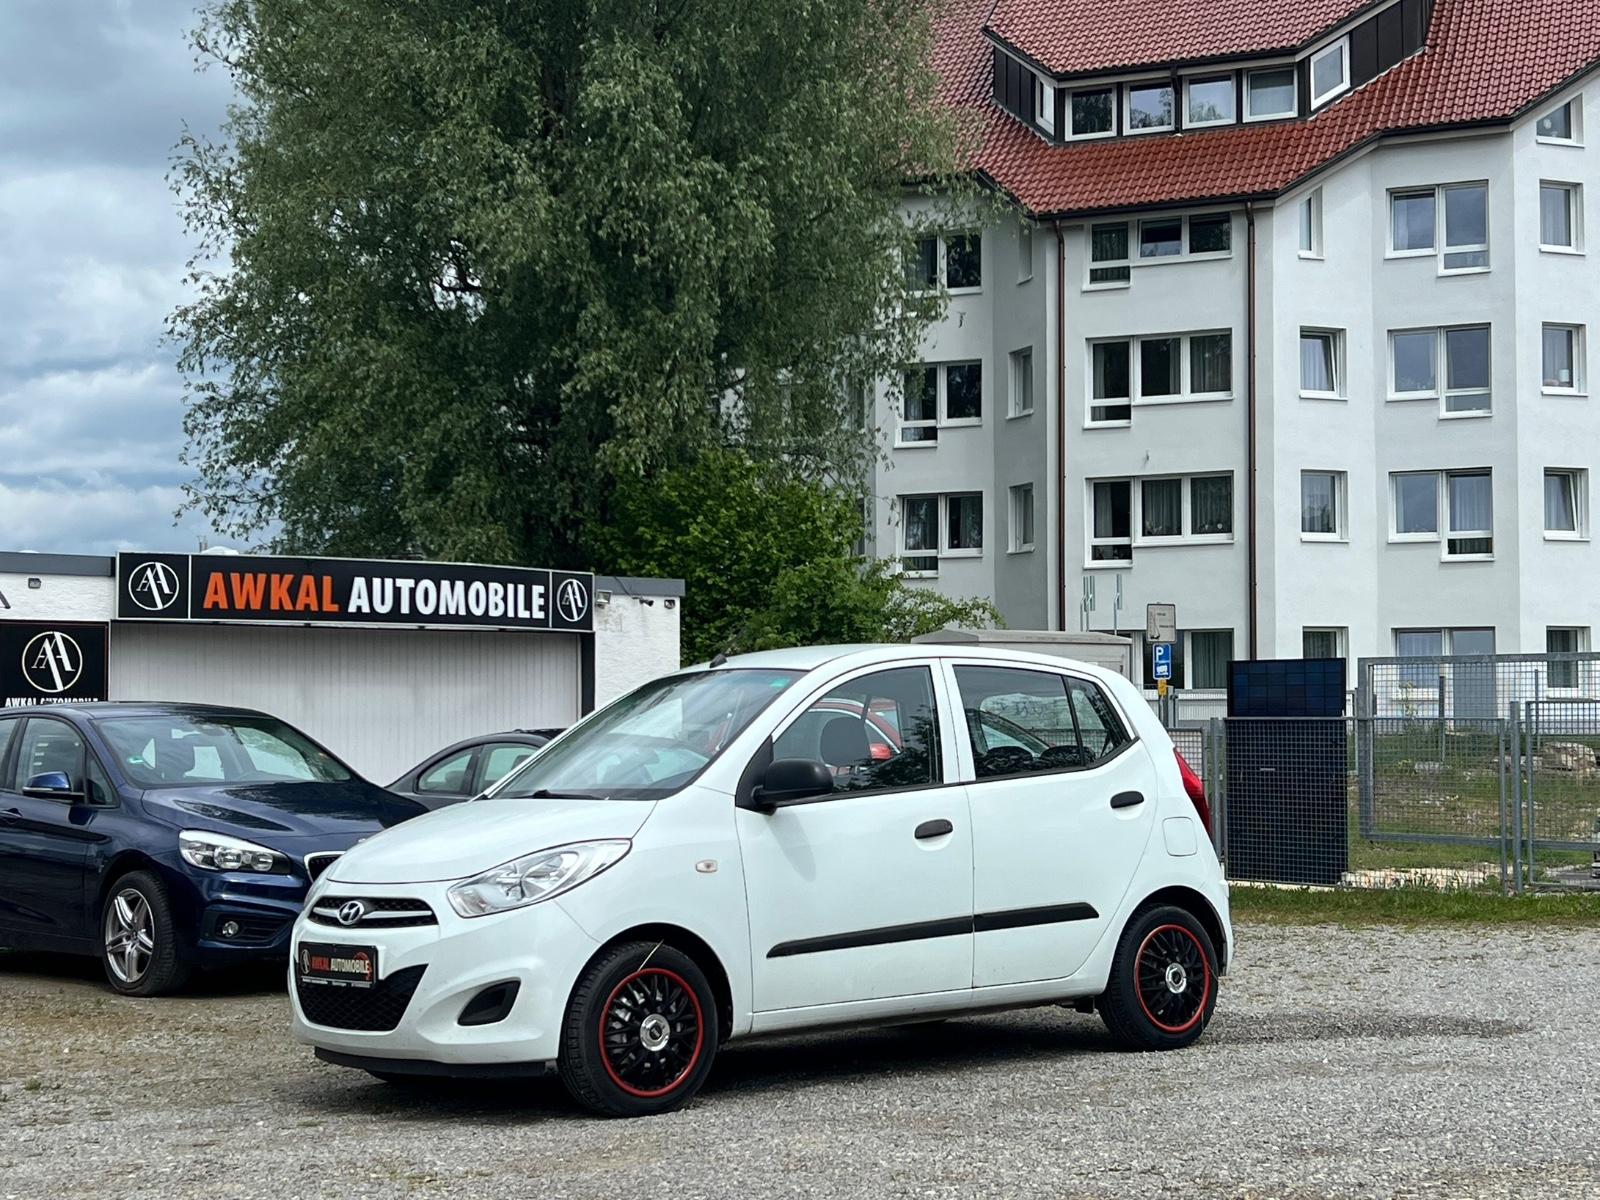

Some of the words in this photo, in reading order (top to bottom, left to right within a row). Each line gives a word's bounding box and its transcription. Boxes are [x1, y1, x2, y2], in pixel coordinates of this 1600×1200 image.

[203, 572, 339, 612] AWKAL
[348, 576, 546, 619] AUTOMOBILE
[1156, 646, 1164, 661] P
[330, 958, 369, 973] AUTOMOBILE
